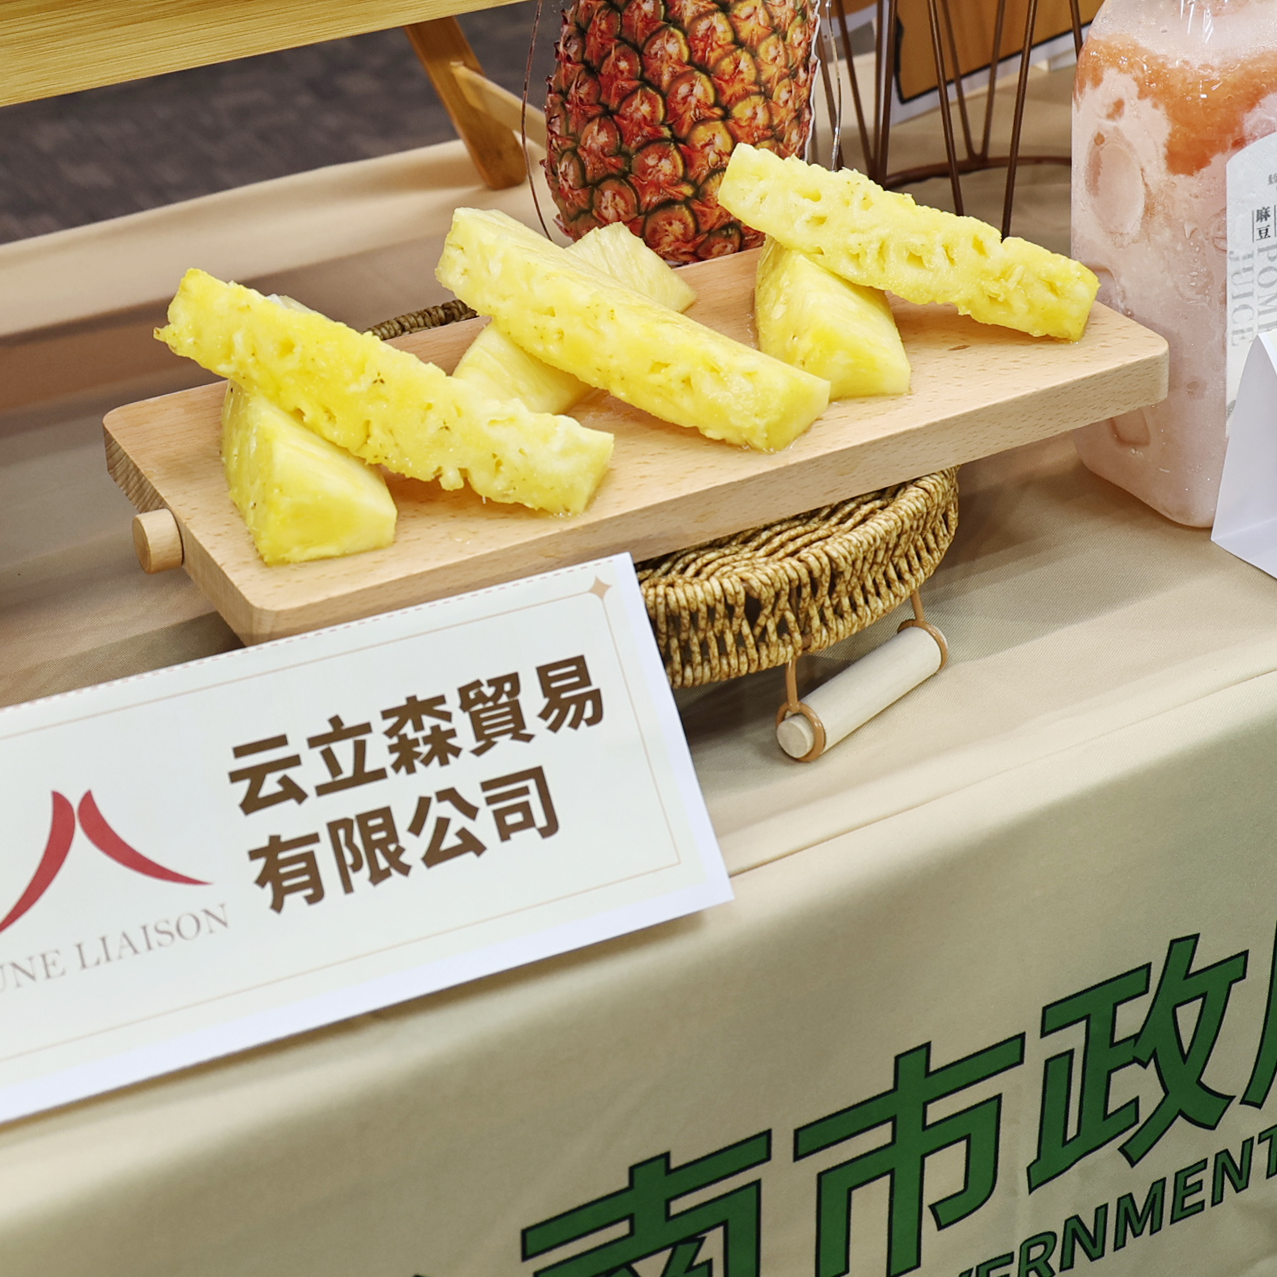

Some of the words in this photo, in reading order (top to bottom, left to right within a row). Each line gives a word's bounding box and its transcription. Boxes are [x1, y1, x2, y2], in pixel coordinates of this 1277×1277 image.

[1256, 207, 1272, 240] 麻豆
[1229, 249, 1255, 348] JUICE
[227, 654, 606, 816] 云立森貿易
[247, 765, 560, 914] 有限公司
[78, 903, 233, 970] LIAISON
